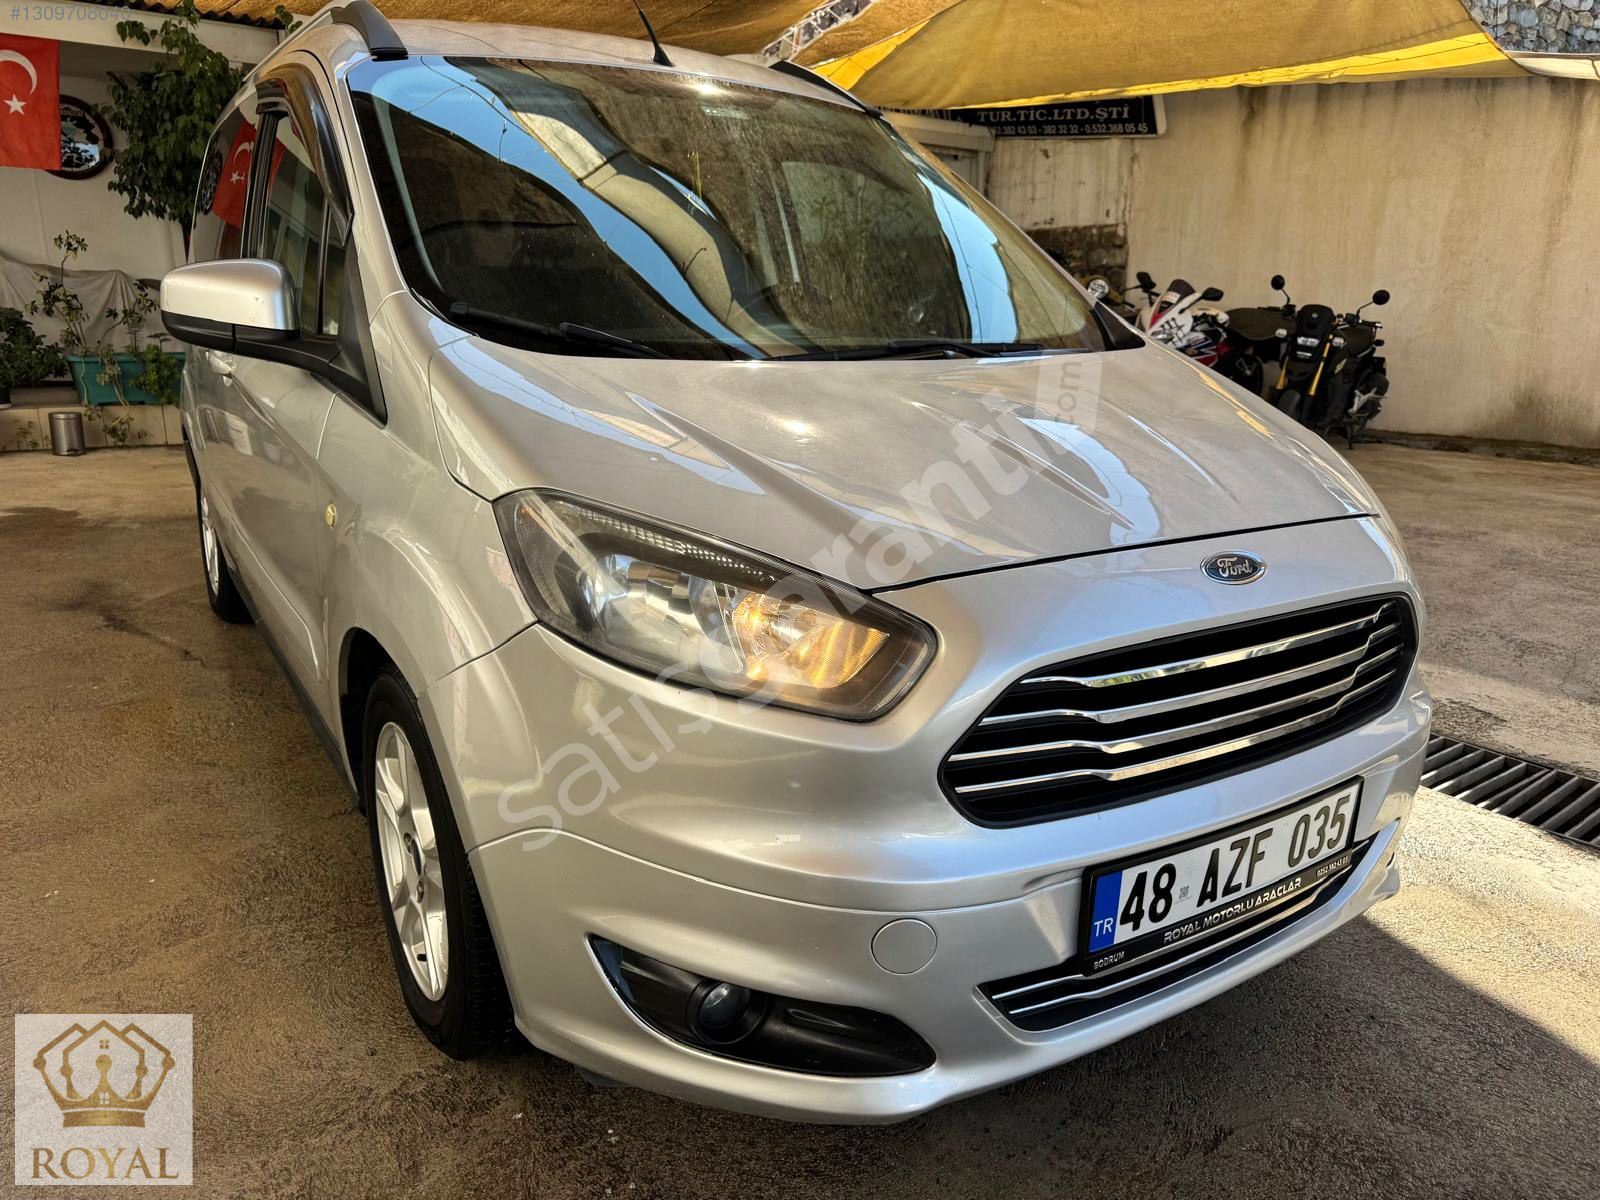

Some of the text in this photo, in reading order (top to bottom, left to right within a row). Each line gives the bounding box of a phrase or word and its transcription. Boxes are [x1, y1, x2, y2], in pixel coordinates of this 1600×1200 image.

[1217, 556, 1253, 578] Ford
[1093, 793, 1351, 937] TR 48 AZF 035
[1163, 920, 1202, 945] ROYAL
[1202, 898, 1255, 929] MOTORLU
[1093, 950, 1126, 971] BODRUM
